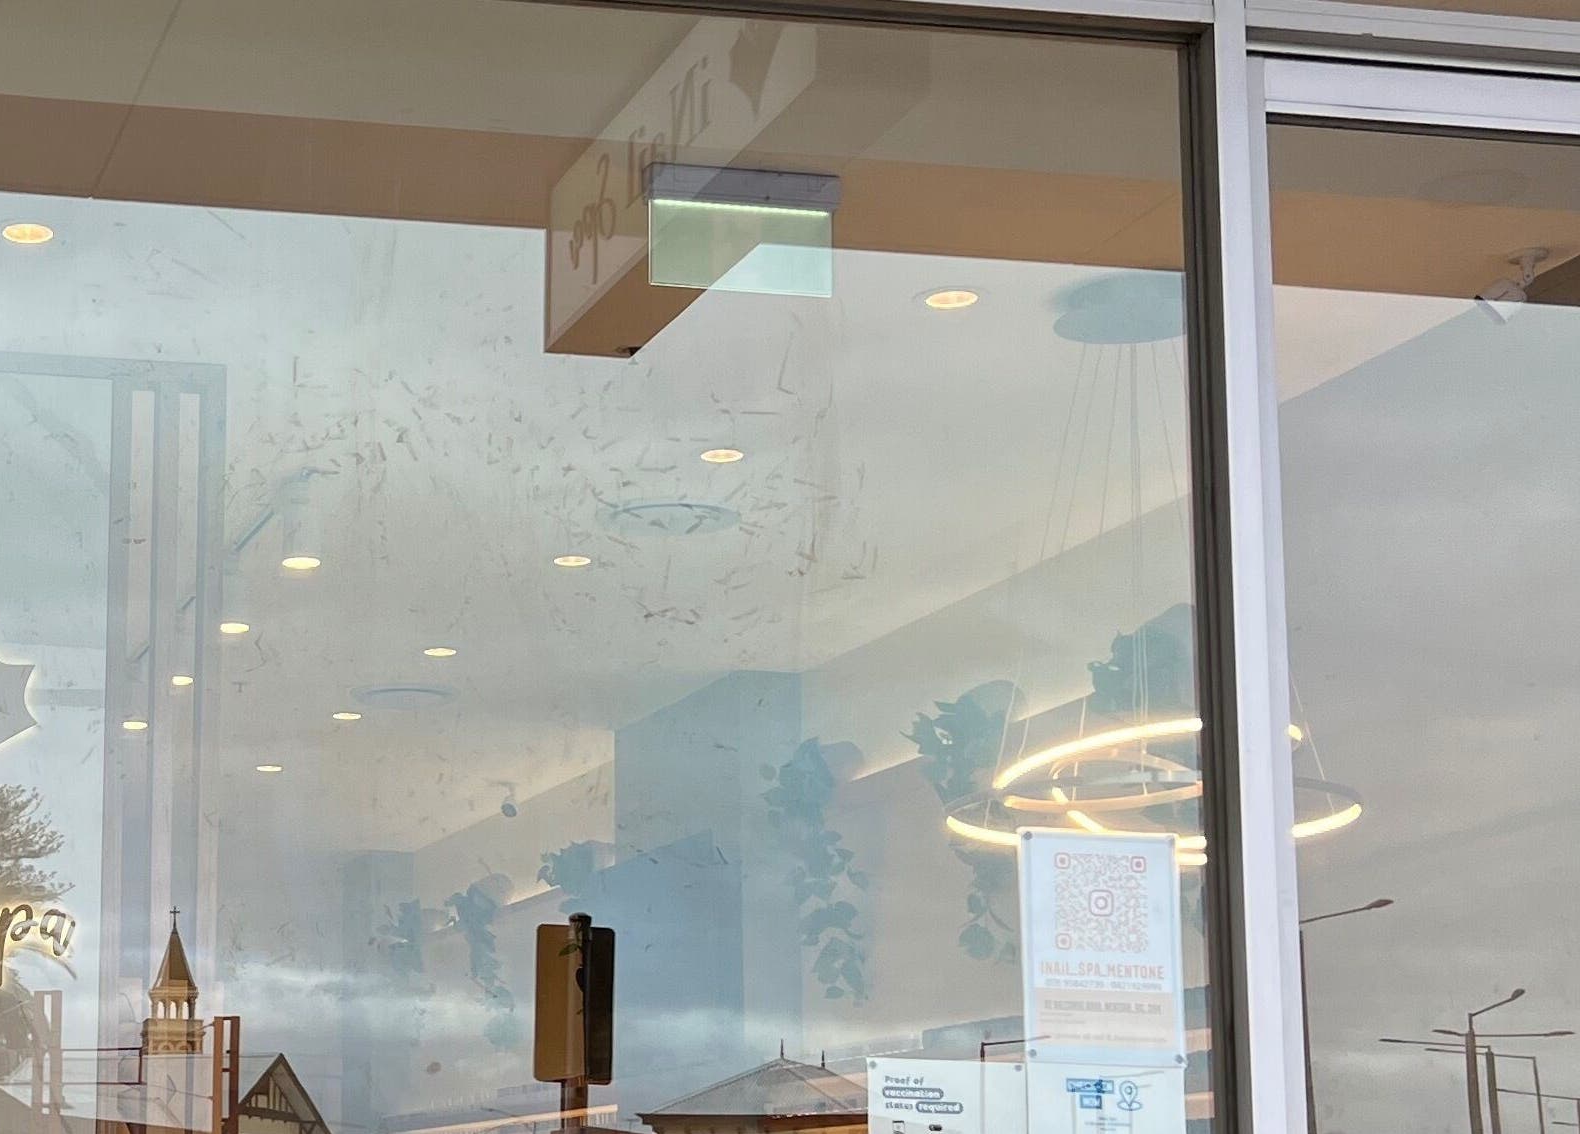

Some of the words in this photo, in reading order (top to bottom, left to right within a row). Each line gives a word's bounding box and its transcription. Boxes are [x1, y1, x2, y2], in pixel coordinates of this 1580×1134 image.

[884, 1075, 910, 1085] Proof
[913, 1076, 924, 1086] of
[884, 1088, 941, 1099] vaccination
[885, 1101, 913, 1110] status
[918, 1102, 961, 1113] required
